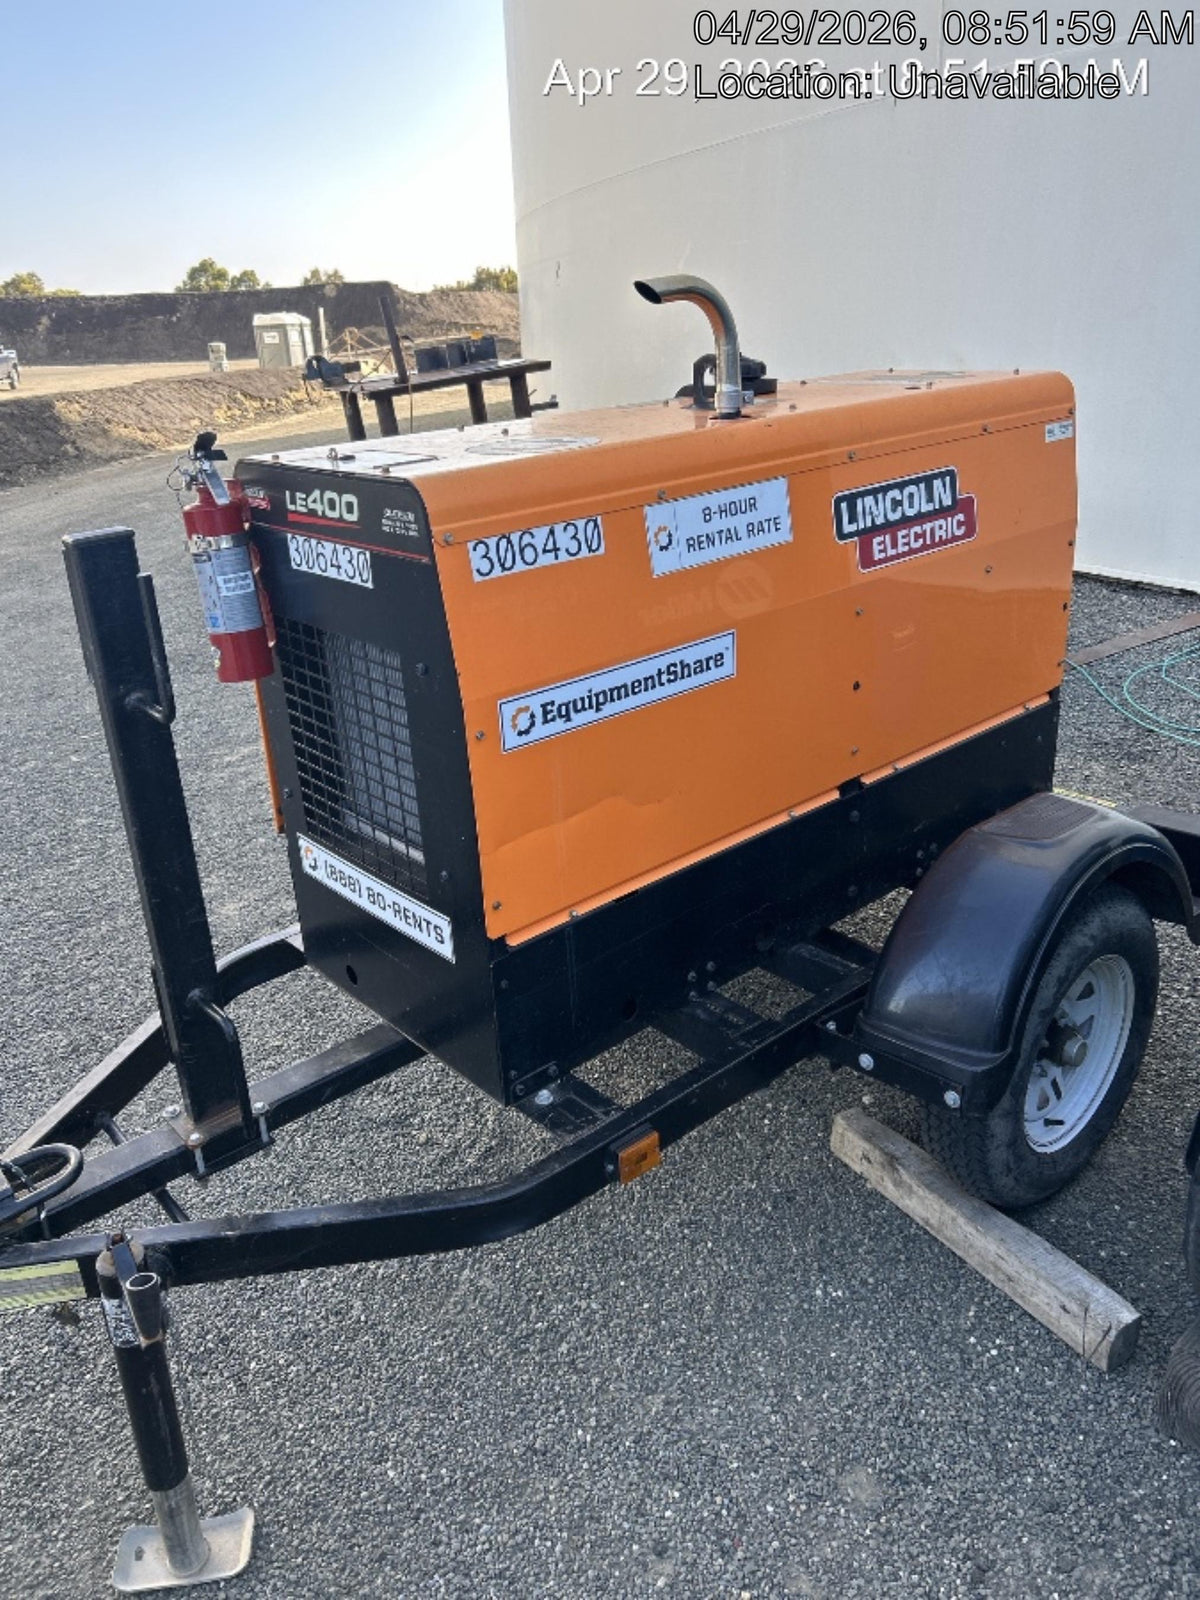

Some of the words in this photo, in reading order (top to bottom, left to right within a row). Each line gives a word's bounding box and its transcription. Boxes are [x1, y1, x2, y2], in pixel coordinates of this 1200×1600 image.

[285, 488, 359, 522] LE400
[702, 496, 758, 523] 8-HOUR
[841, 476, 952, 534] LINCOLN
[472, 517, 601, 577] 306430
[685, 525, 742, 553] RENTAL
[746, 515, 782, 539] RATE
[872, 513, 967, 561] ELECTRIC
[290, 536, 370, 584] 306430
[540, 651, 725, 726] EquipmentShare
[324, 859, 362, 899] (888)
[366, 886, 446, 945] 80-RENTS
